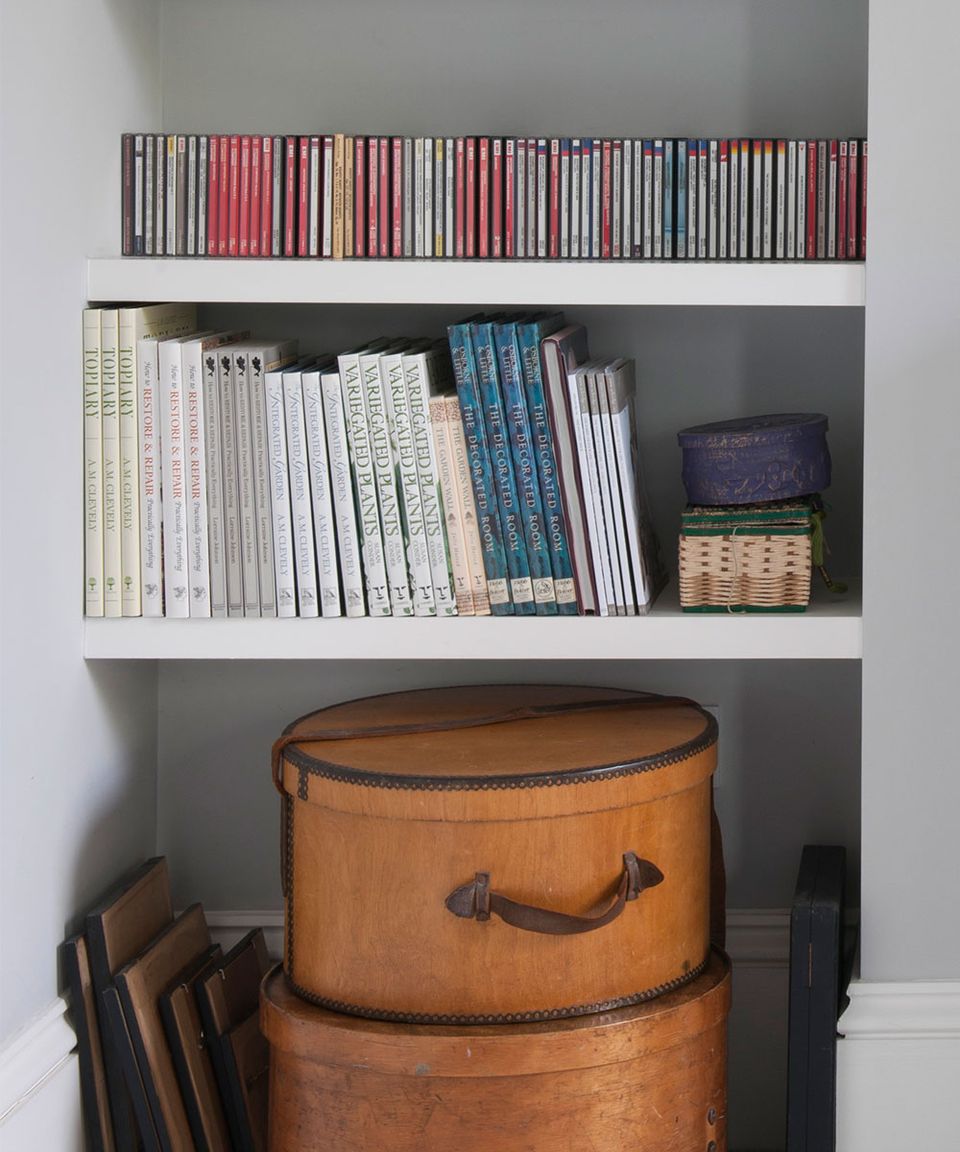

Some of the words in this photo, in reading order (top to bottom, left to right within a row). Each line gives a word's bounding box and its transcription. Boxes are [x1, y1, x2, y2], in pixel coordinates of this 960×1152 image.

[85, 347, 100, 420] TOPIARY
[119, 347, 134, 419] TOPIARY
[143, 361, 153, 379] How
[455, 356, 464, 384] LITTLE
[142, 387, 153, 439] RESTORE
[188, 391, 199, 443] RESTORE
[268, 388, 284, 457] INTEGRATED
[345, 364, 370, 469] VARIEGATED
[464, 403, 475, 429] THE
[143, 443, 153, 453] &
[406, 364, 431, 469] VARIEGATED
[419, 472, 442, 537] PLANTS
[468, 434, 489, 509] DECORATED
[144, 456, 155, 497] REPAIR
[190, 460, 201, 500] REPAIR
[270, 457, 286, 501] GARDEN
[439, 449, 450, 486] GARDEN
[446, 489, 455, 512] WALL
[537, 434, 557, 509] DECORATED
[550, 515, 563, 552] ROOM
[87, 484, 98, 532] CLEVELY
[122, 482, 133, 531] CLEVELY
[145, 499, 156, 532] Practically
[357, 472, 379, 537] PLANTS
[145, 534, 157, 569] Everything
[481, 516, 495, 552] ROOM
